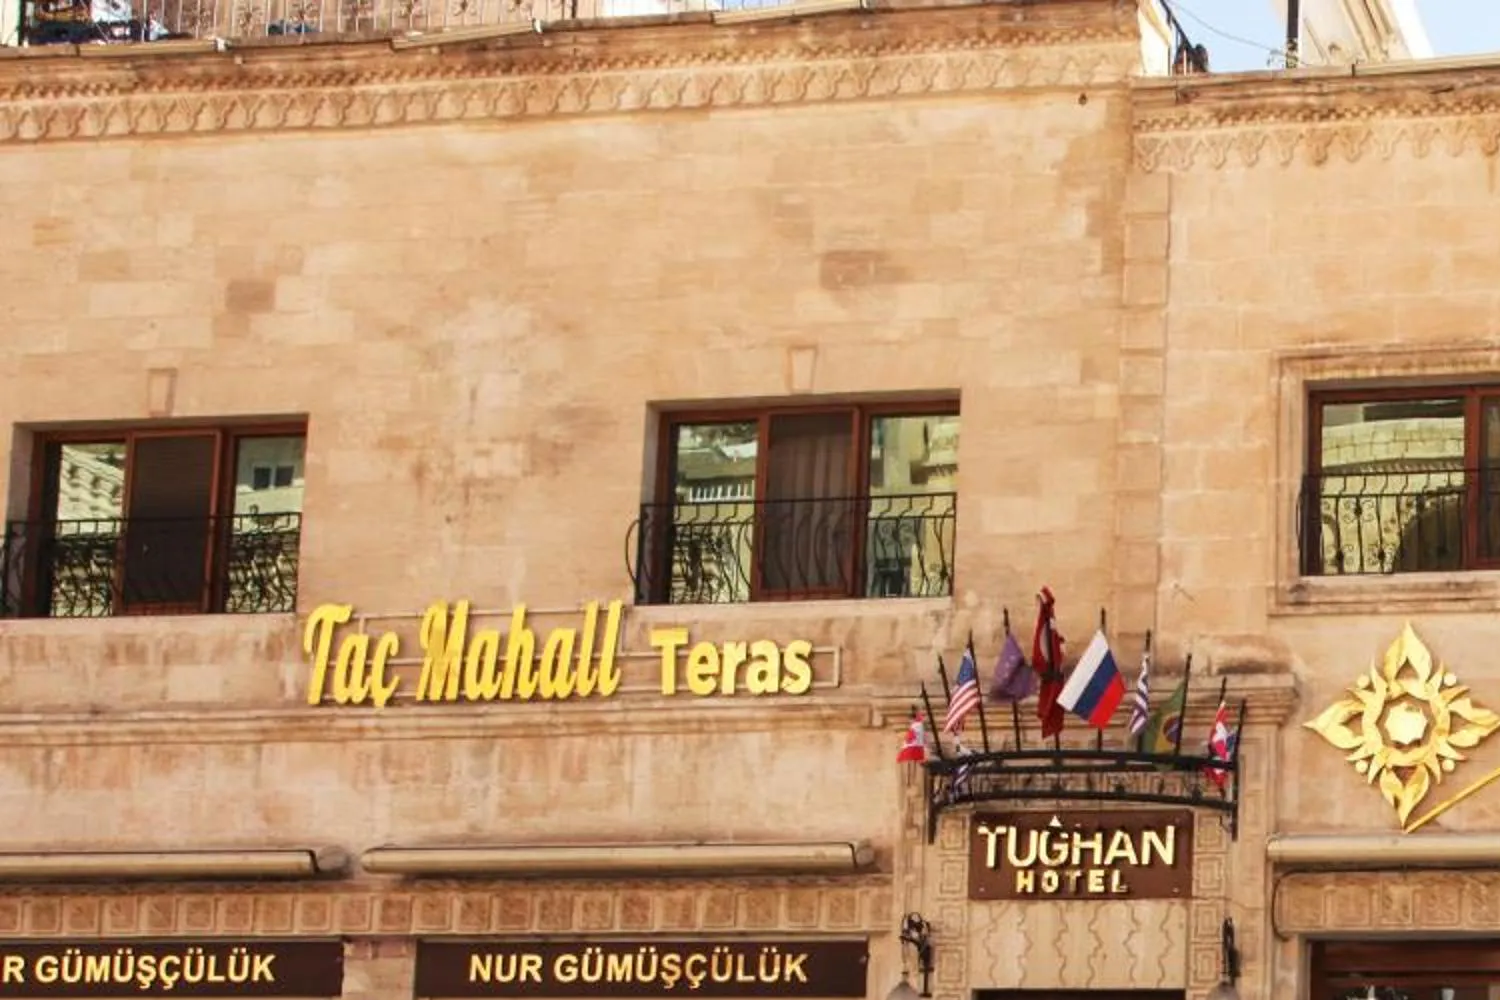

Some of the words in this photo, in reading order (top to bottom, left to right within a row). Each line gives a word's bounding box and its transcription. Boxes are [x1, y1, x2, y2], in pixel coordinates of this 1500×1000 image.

[303, 602, 399, 710] Taç
[416, 599, 624, 701] Mahall
[650, 627, 814, 695] Teras
[1016, 869, 1128, 893] HOTEL
[35, 947, 276, 989] GÜMÜŞÇÜLÜK
[469, 954, 543, 982] NUR
[554, 947, 808, 989] GÜMÜŞÇÜLÜK
